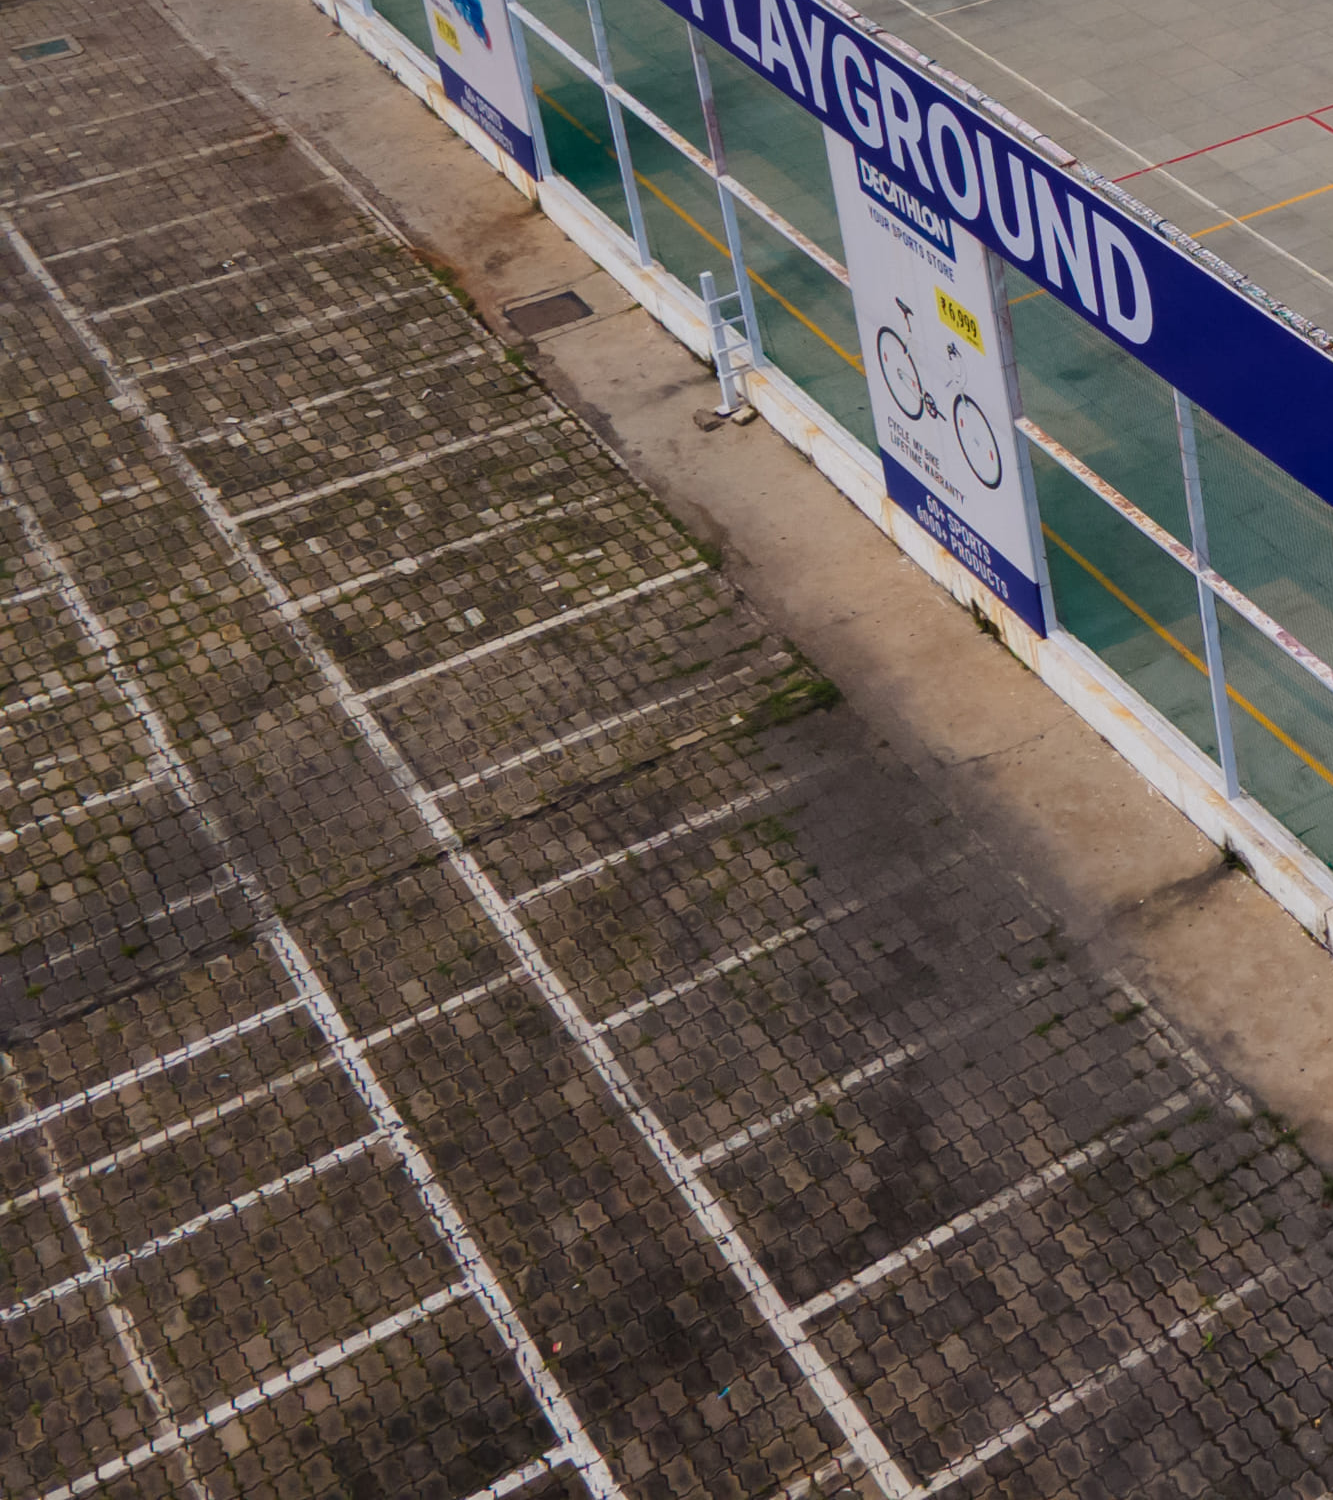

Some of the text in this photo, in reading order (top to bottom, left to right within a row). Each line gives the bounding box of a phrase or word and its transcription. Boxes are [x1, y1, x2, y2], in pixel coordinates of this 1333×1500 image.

[859, 156, 950, 248] DECATHLON
[868, 203, 955, 284] YOUR SPORTS STORE
[887, 416, 910, 443] CYCLE
[924, 445, 940, 470] BIKE
[889, 430, 965, 505] LIFETIME WARRANTY
[947, 513, 991, 565] SPORTS
[950, 534, 1009, 600] PRODUCTS
